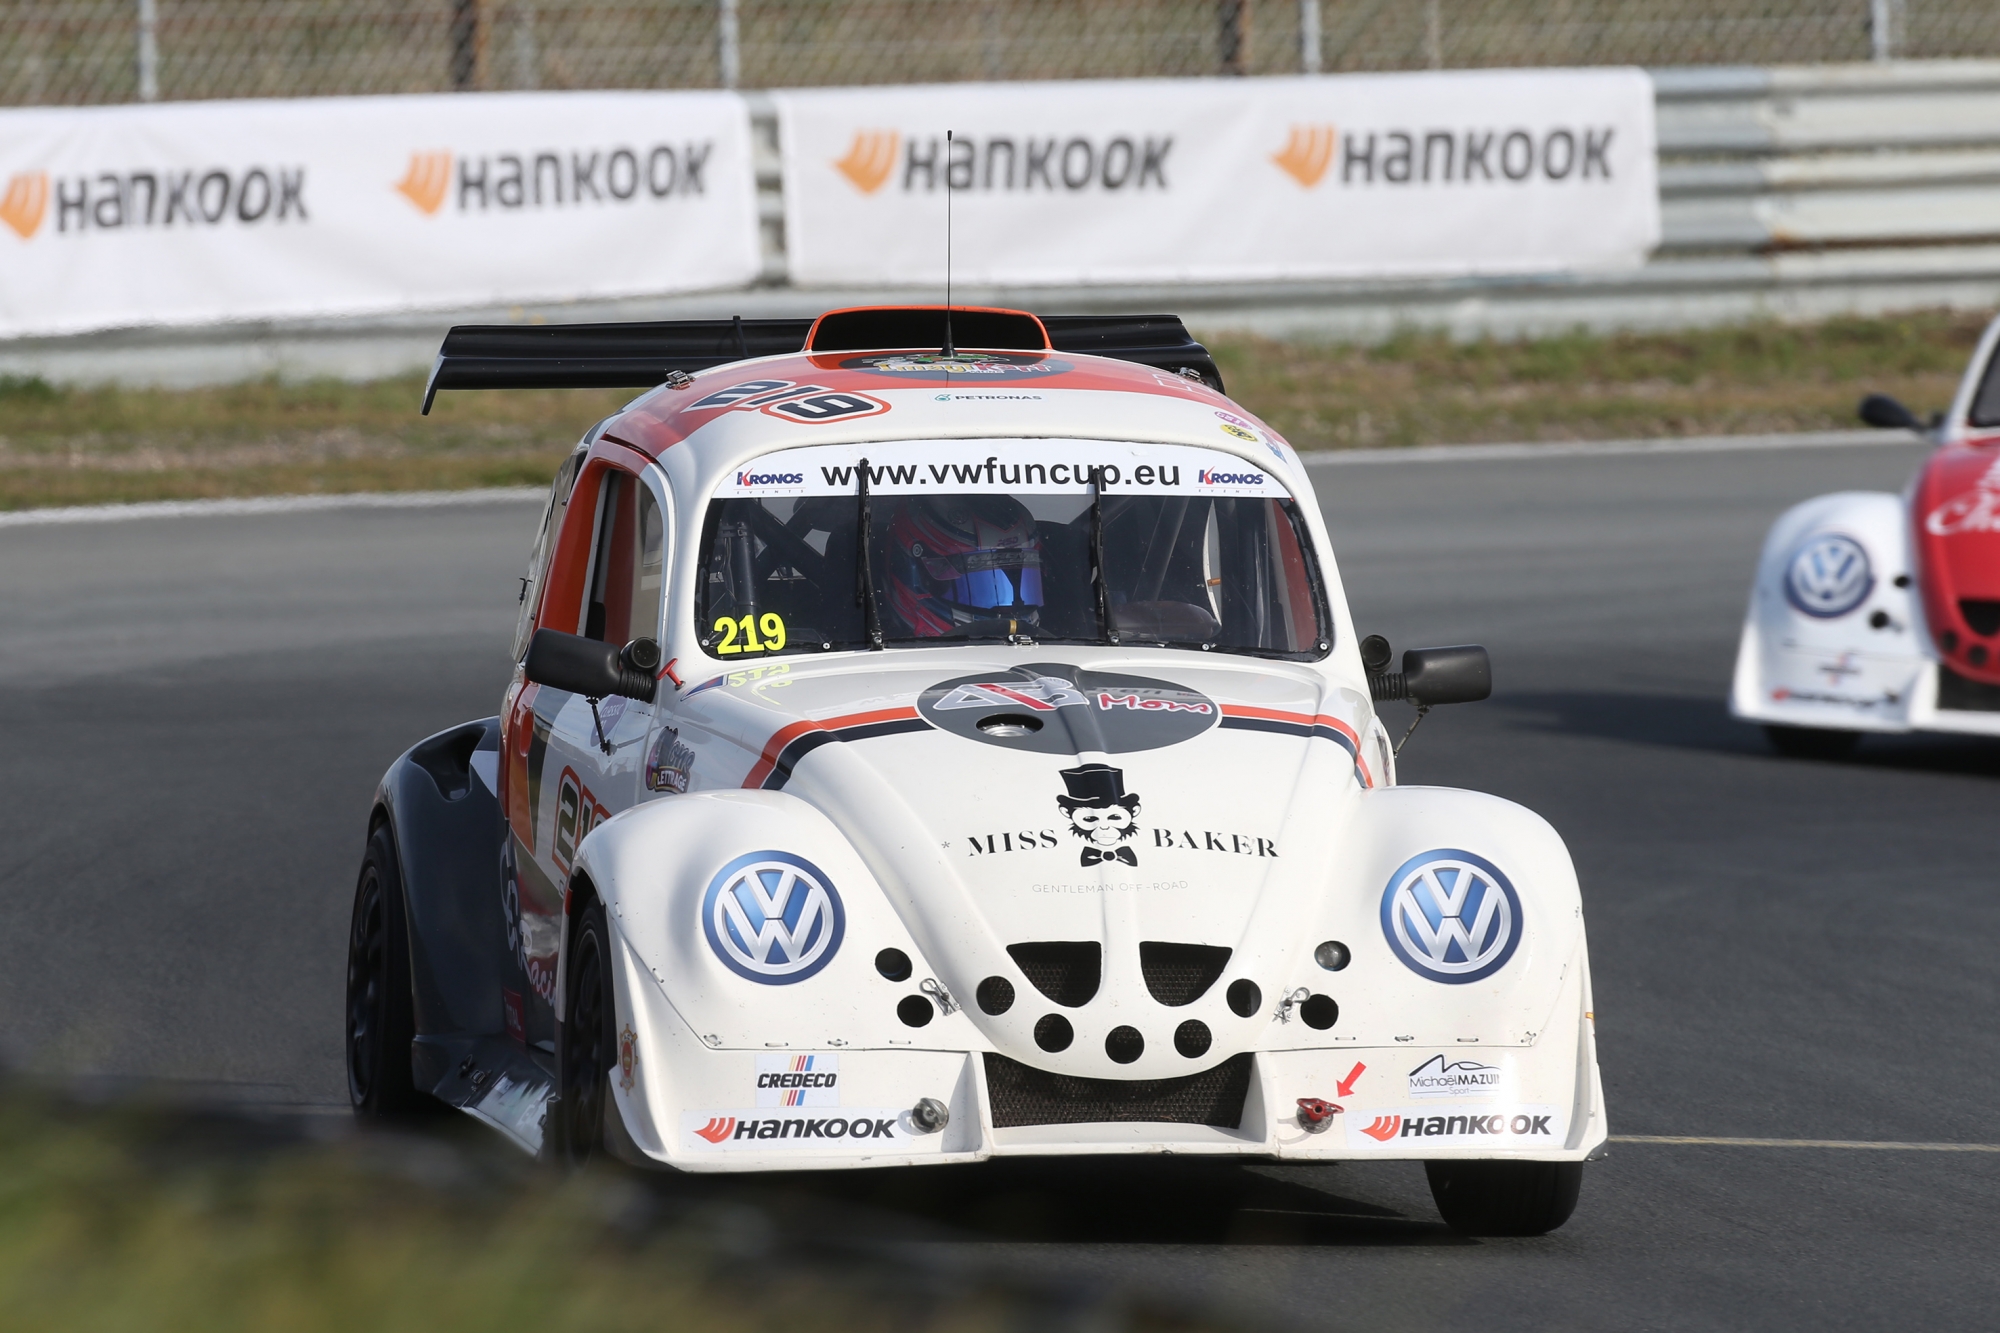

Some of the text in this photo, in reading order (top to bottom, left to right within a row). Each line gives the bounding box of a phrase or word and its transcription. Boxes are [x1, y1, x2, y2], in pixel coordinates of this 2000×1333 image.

[686, 378, 880, 421] 219
[736, 467, 804, 487] KRONOS
[820, 456, 1181, 493] www.vwfuncup.eu
[1198, 466, 1264, 485] KRONOS
[714, 613, 787, 655] 219
[967, 828, 1280, 858] MISS BAKER
[1031, 882, 1114, 894] GENTLEMAN
[757, 1073, 837, 1089] CREDECO
[1448, 1086, 1470, 1096] Sport
